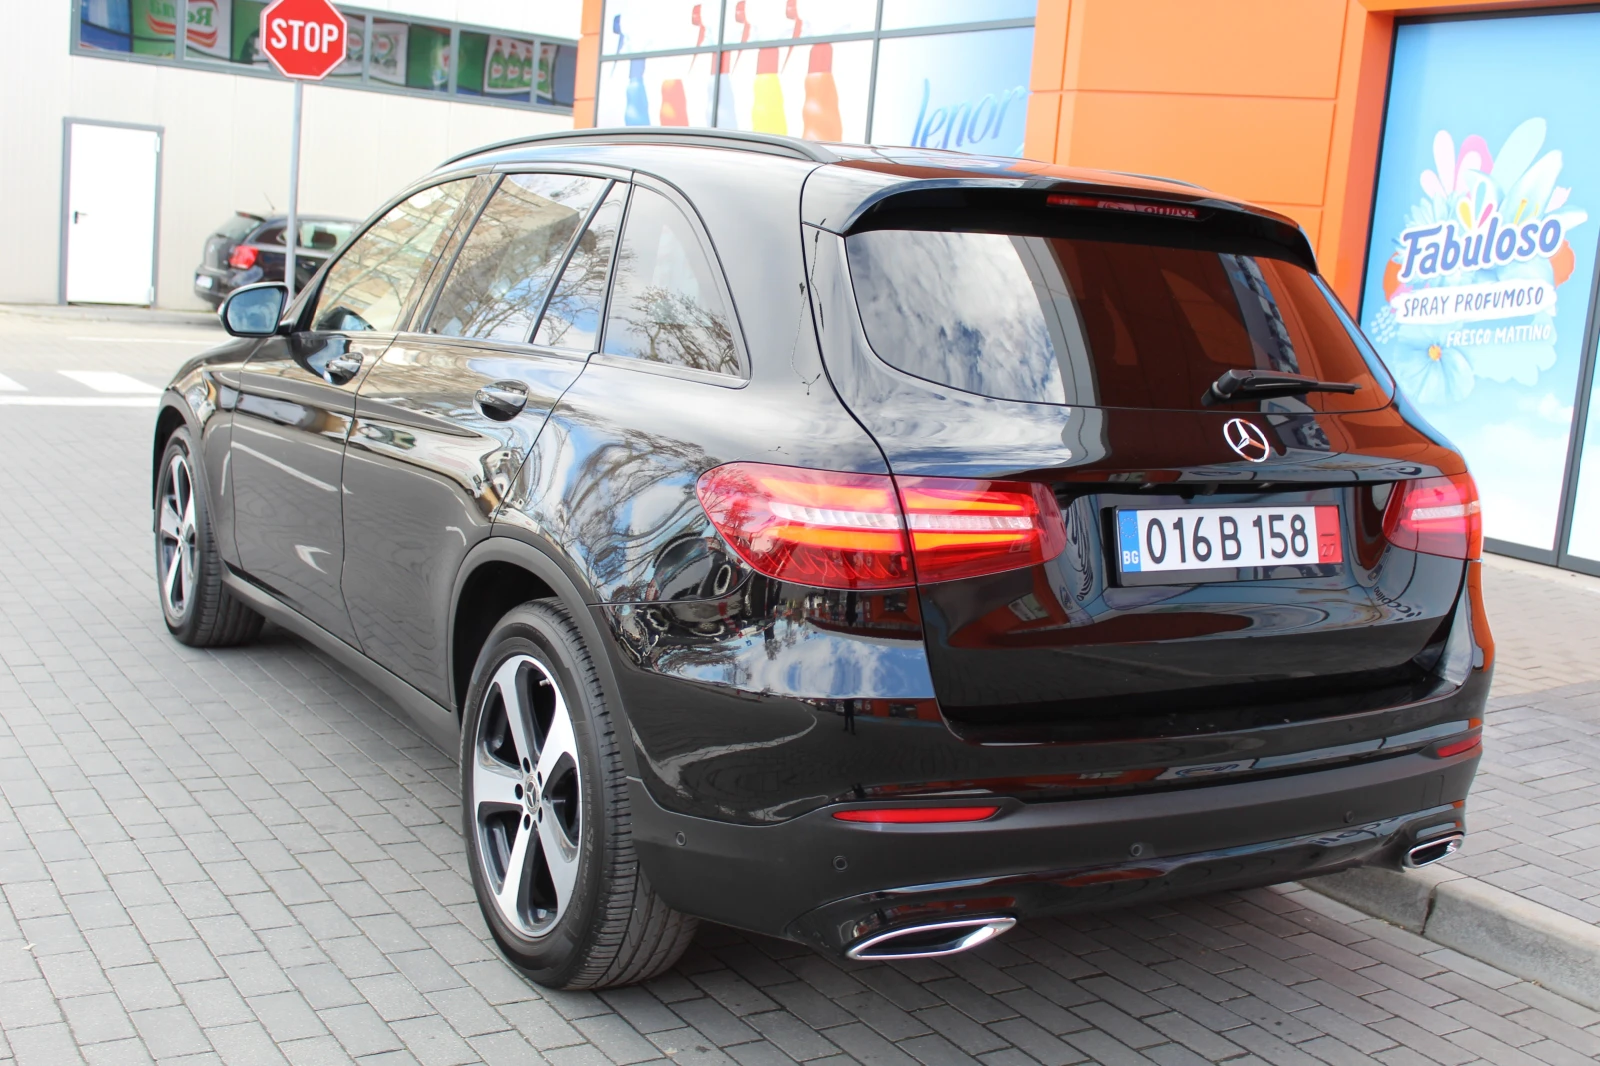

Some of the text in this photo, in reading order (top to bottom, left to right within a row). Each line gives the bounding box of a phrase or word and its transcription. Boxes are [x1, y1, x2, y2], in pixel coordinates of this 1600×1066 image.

[271, 18, 339, 53] STOP
[1401, 217, 1561, 278] Fabuloso
[1403, 286, 1544, 317] SPRAY PROFUMOSO
[1446, 324, 1551, 348] FRESCO MATTINO
[1123, 551, 1139, 565] BG
